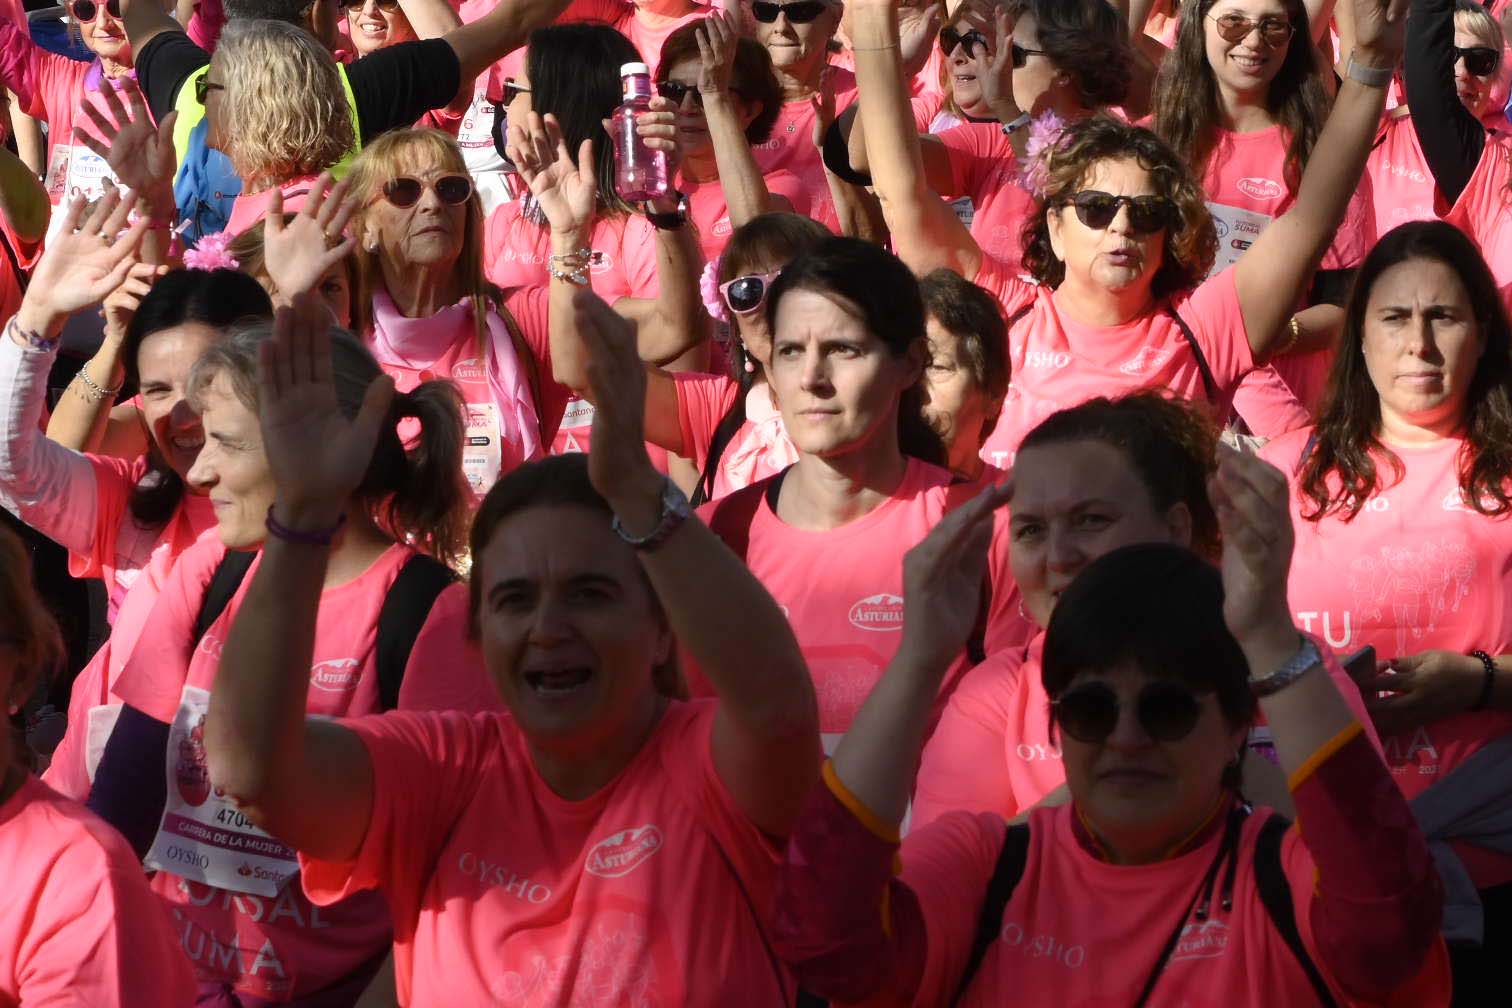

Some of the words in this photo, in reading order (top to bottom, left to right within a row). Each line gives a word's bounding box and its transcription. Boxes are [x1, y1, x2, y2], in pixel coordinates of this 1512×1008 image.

[1234, 223, 1260, 234] SUMA
[1297, 611, 1352, 649] TU
[215, 830, 229, 846] DE
[230, 834, 242, 849] LA
[243, 837, 279, 855] MUJER
[458, 851, 553, 905] OYSHO
